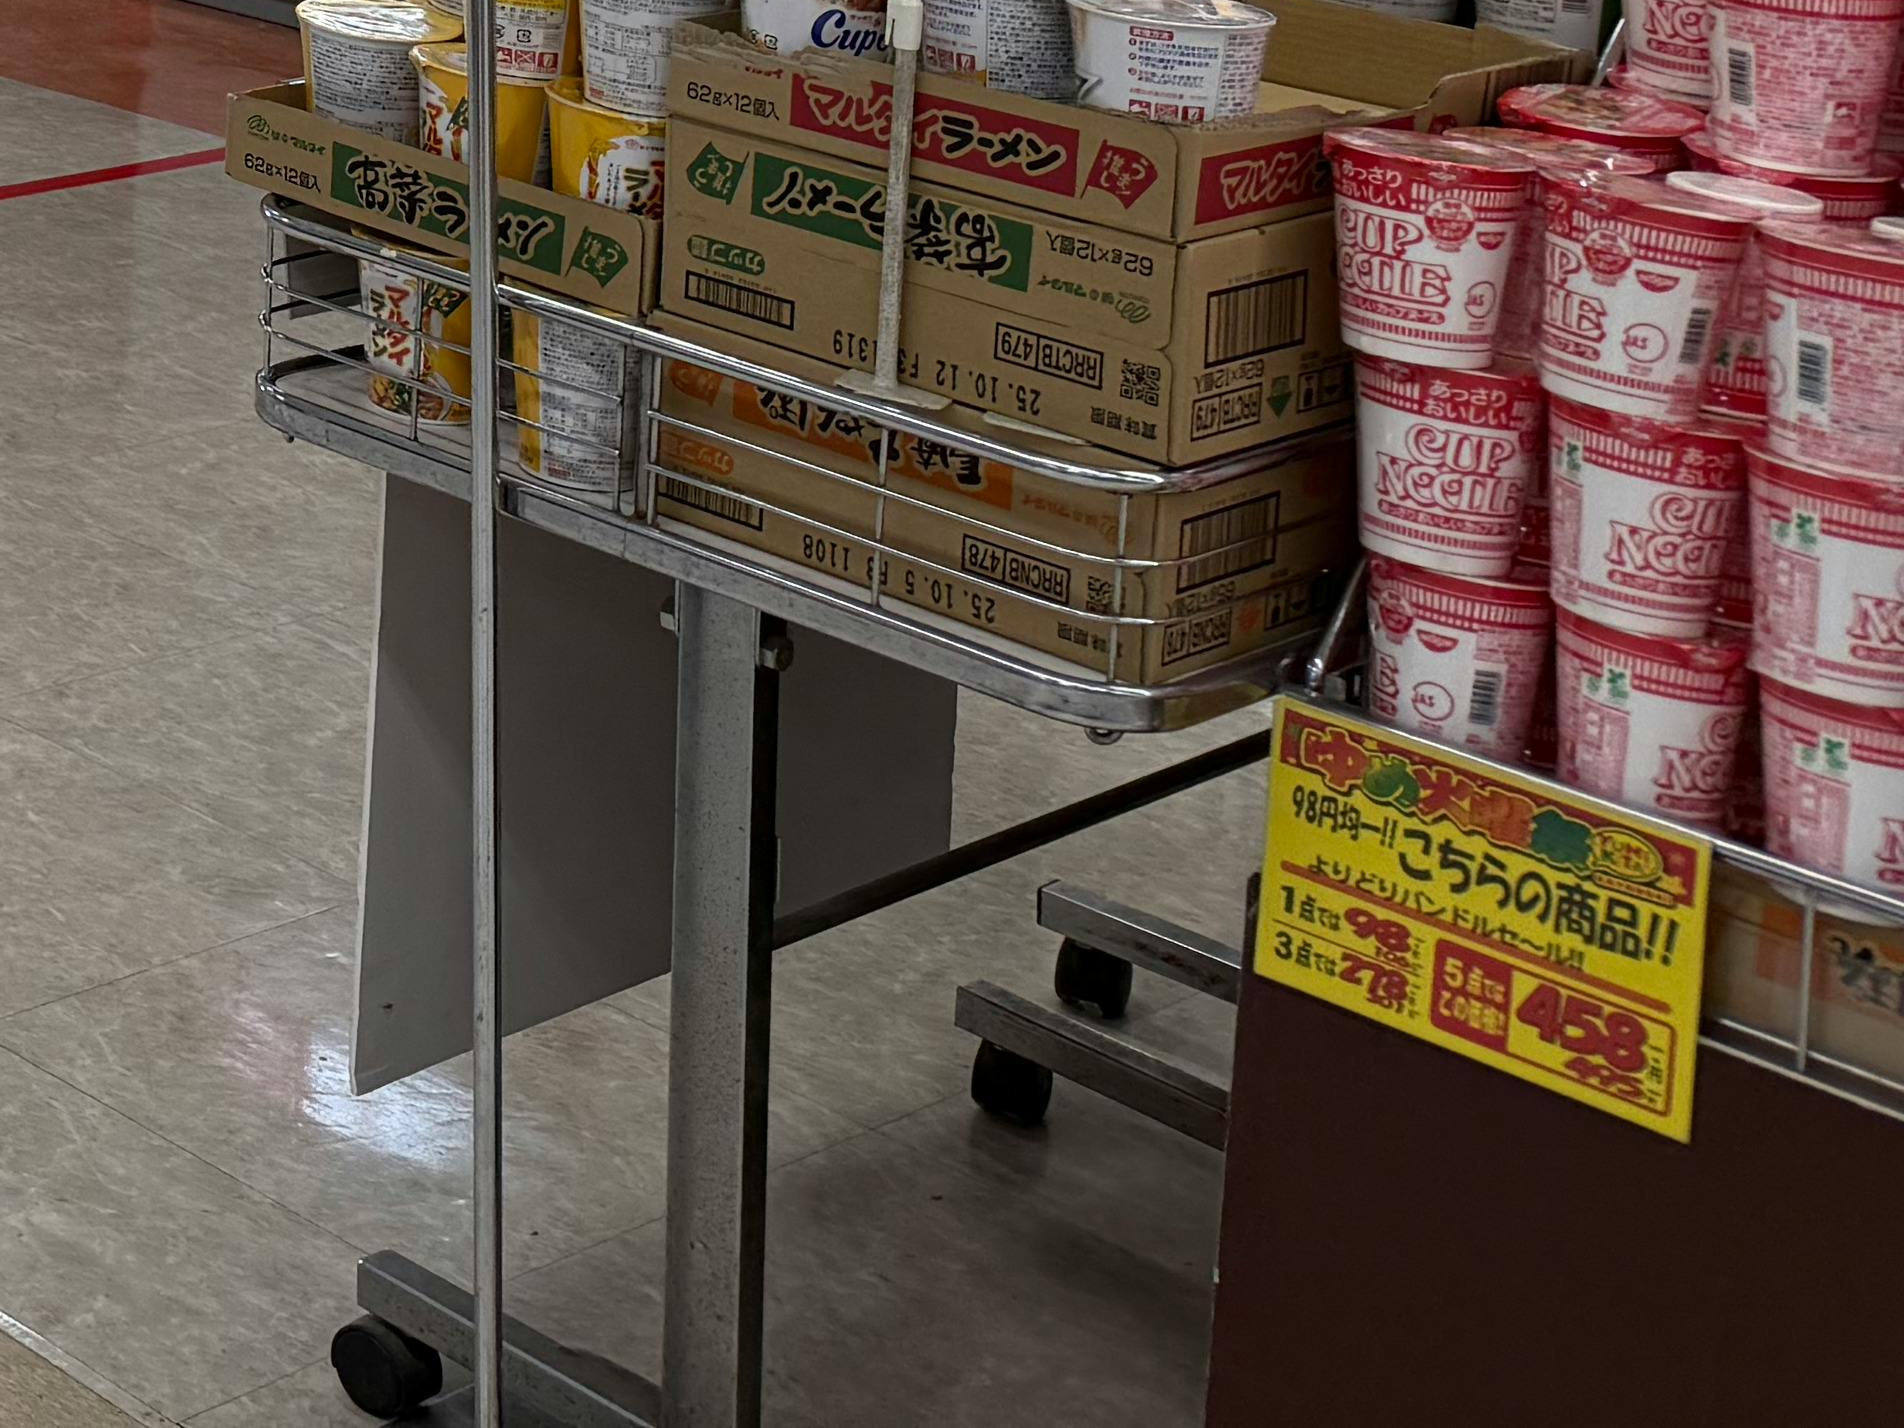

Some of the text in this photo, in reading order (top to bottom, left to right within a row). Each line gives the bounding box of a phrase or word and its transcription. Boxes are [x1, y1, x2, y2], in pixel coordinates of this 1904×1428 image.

[999, 329, 1098, 384] RRCTB 479
[935, 358, 1042, 416] 25.10.12
[1428, 377, 1509, 407] あっさり
[1406, 422, 1516, 476] CUP
[967, 540, 1066, 600] RRCNB 478
[1397, 826, 1680, 968] こちらの商品!!
[1344, 907, 1414, 954] 98
[1337, 953, 1409, 1002] 278
[1515, 984, 1648, 1073] 458
